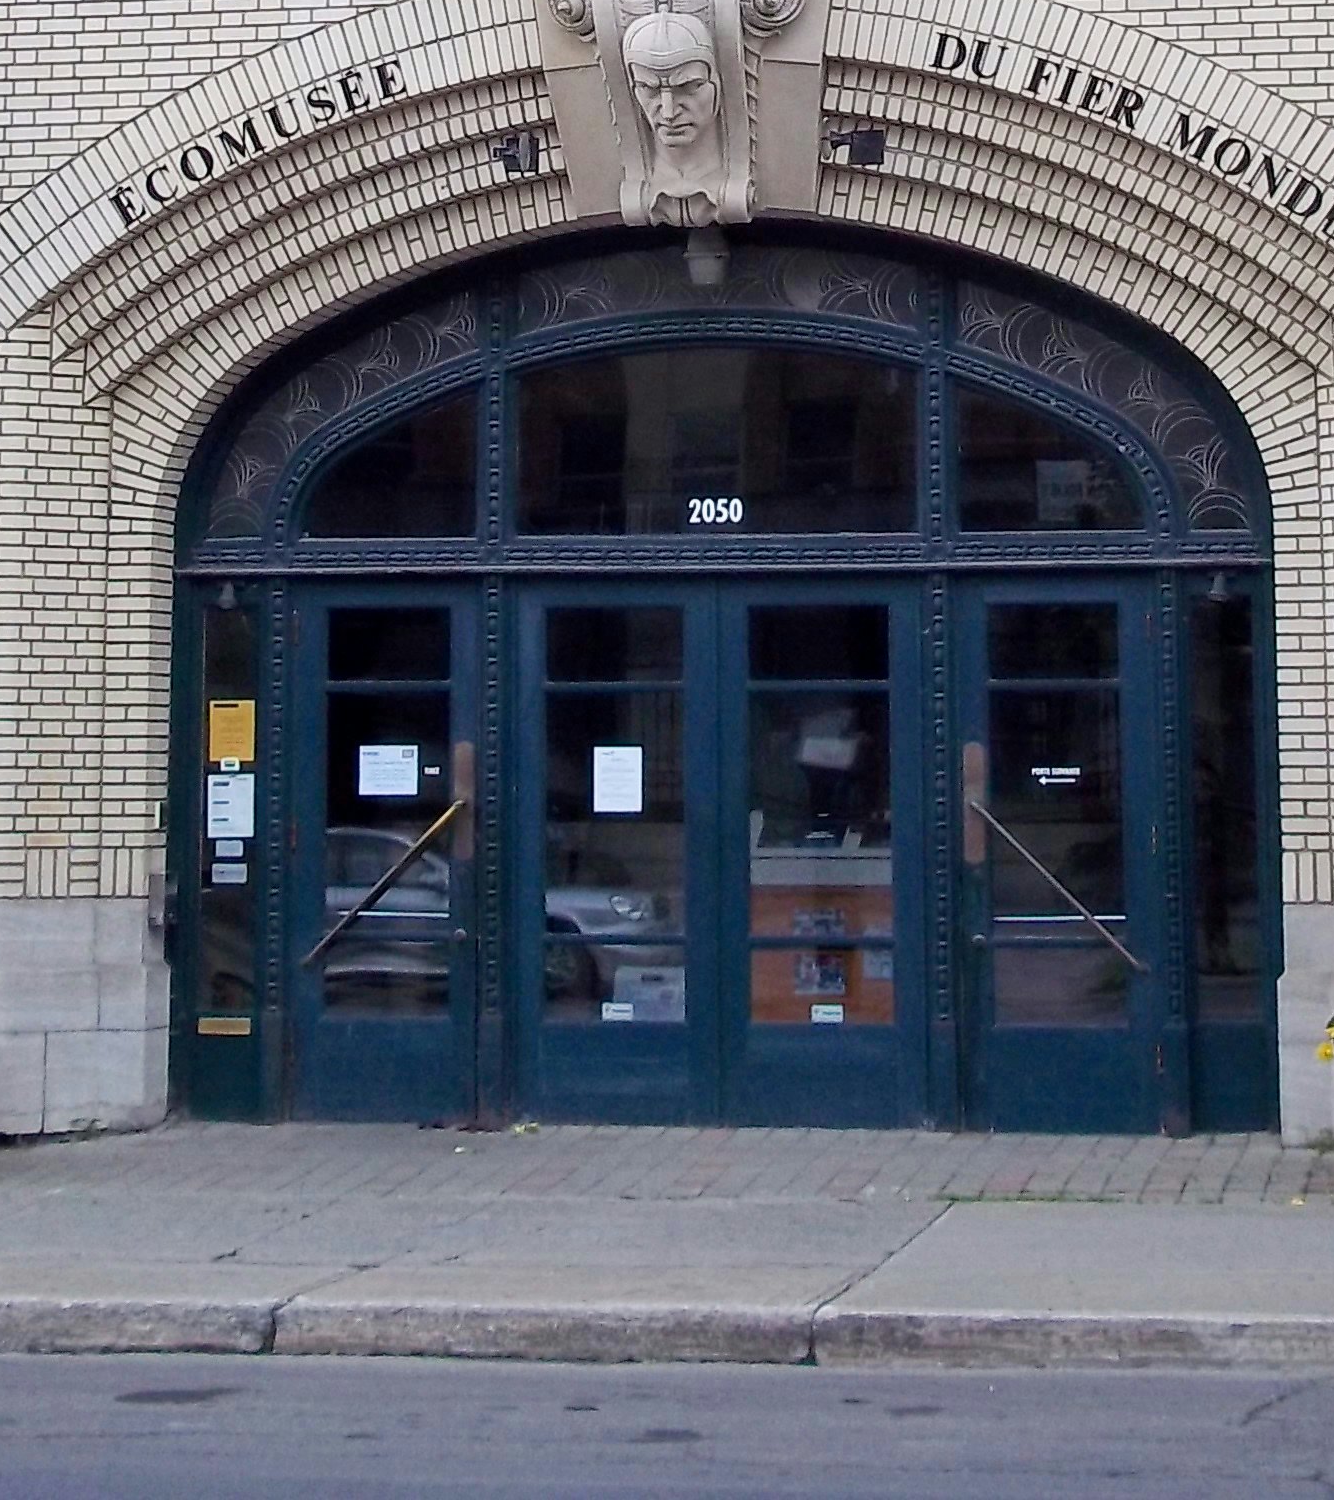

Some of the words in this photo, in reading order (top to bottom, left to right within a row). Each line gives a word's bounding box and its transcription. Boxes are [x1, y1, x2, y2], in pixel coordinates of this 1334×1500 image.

[109, 59, 408, 228] ÉCOMUSÉE
[929, 32, 1009, 79] DU
[1023, 51, 1145, 130] FIER
[689, 498, 743, 523] 2050
